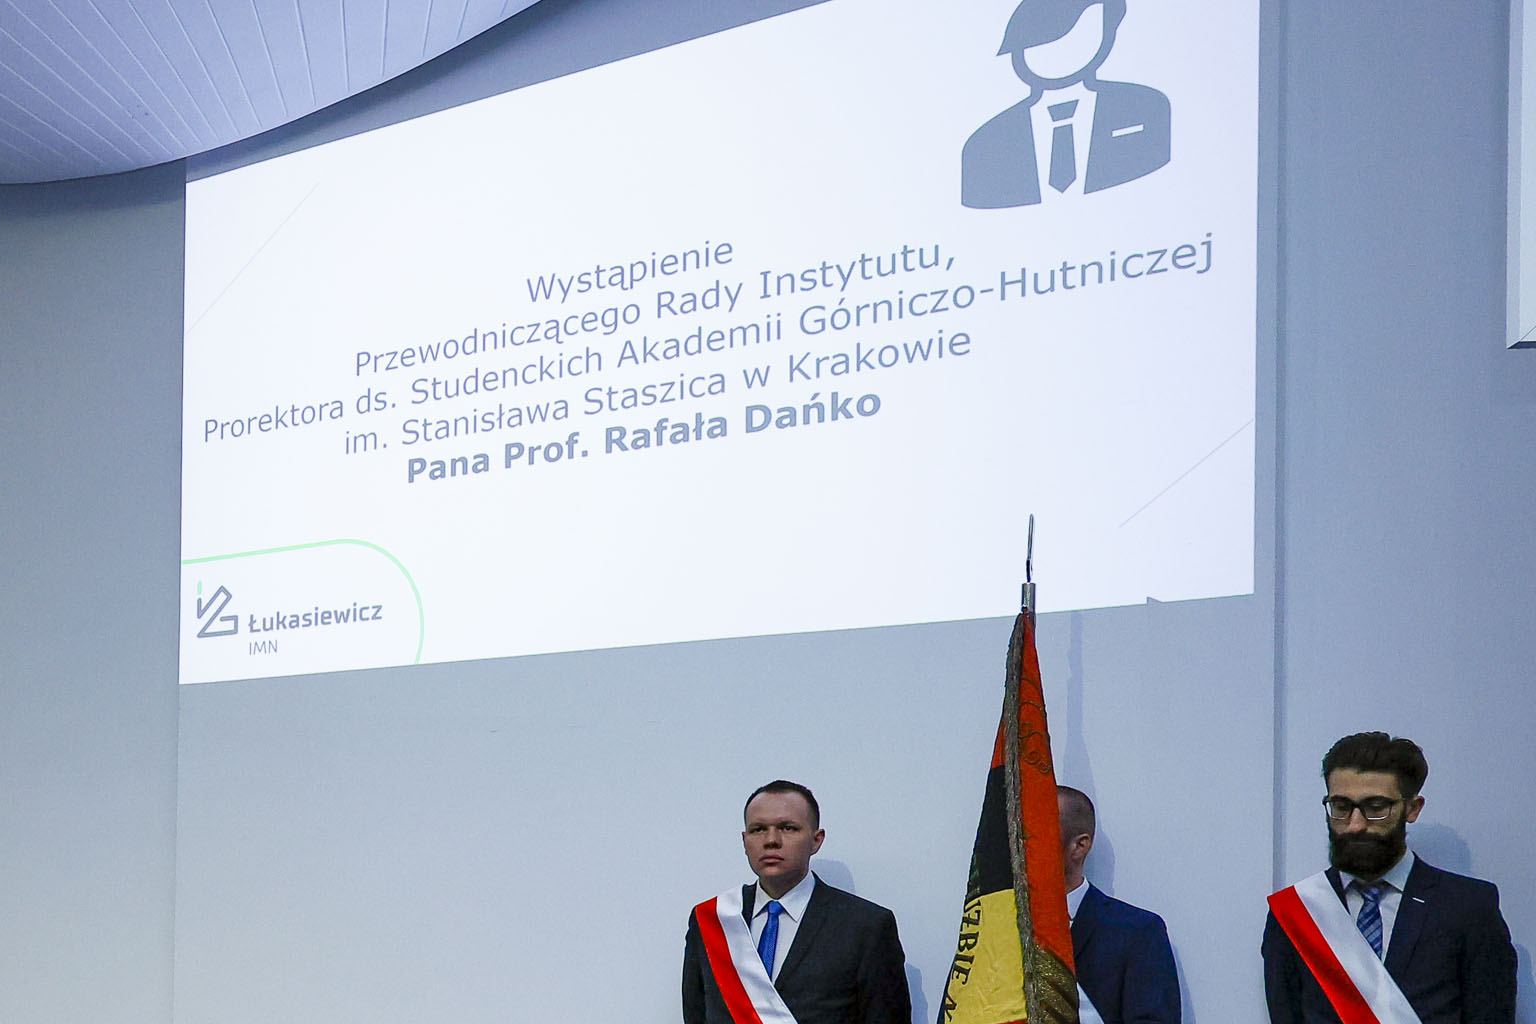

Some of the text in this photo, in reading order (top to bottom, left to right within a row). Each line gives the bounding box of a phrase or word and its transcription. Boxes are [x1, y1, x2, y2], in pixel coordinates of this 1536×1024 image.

[355, 243, 955, 377] Przewodniczącego Rady Instytutu,
[527, 240, 734, 305] Wystąpienie
[204, 231, 1213, 444] Prorektora ds. Studenckich Akademii Górniczo-Hutniczej
[344, 329, 971, 457] im. Stanisława Staszica w Krakowie
[407, 391, 882, 484] Pana Prof. Rafała Dańko
[248, 602, 383, 634] Łukasiewicz
[248, 639, 279, 656] IMN
